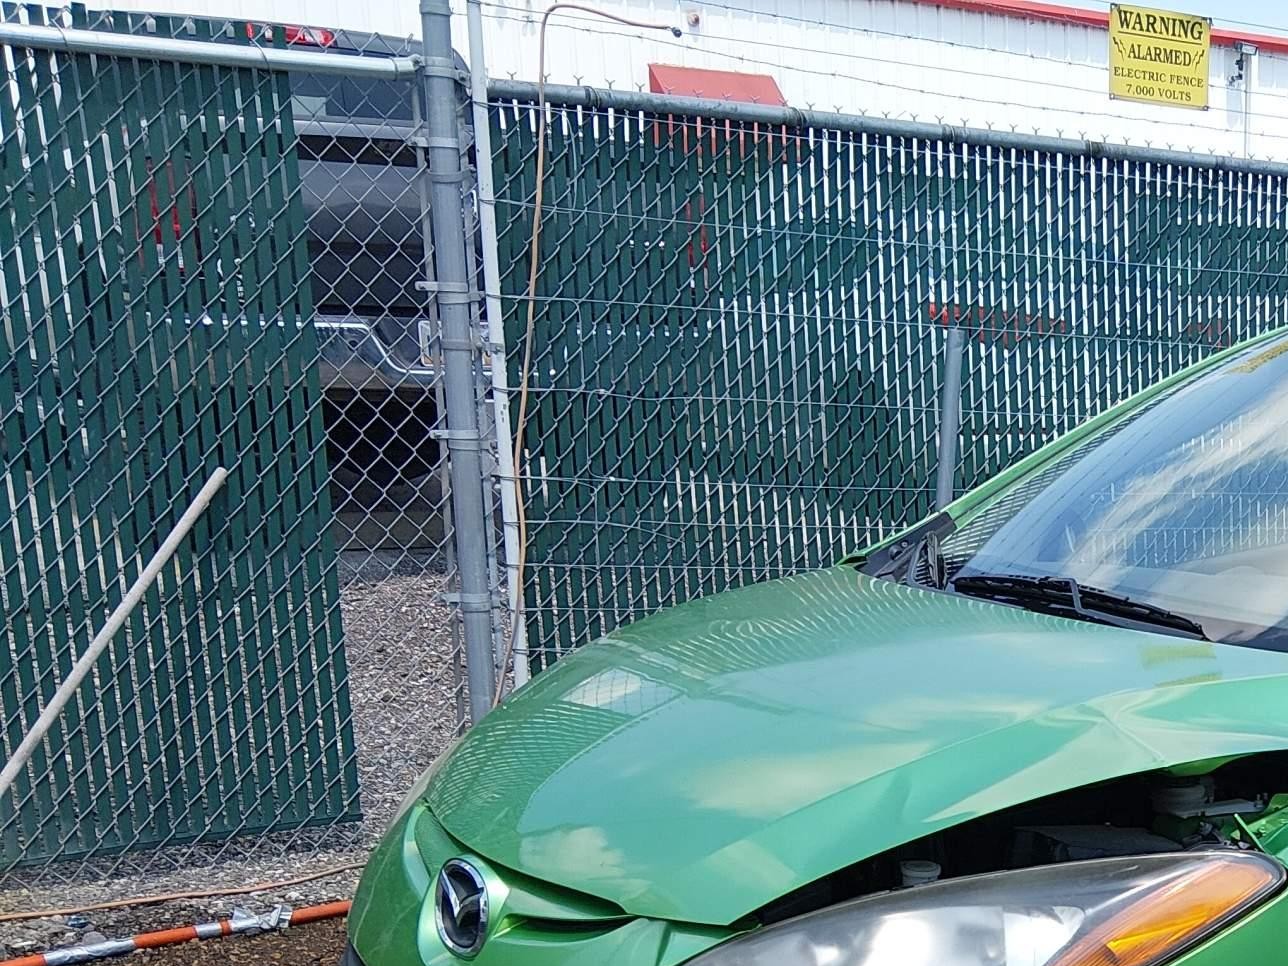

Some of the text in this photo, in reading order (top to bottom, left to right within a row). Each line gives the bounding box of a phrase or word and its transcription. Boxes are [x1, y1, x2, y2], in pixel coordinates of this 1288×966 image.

[1117, 9, 1204, 41] WARNING
[1128, 43, 1192, 67] ALARMED
[1114, 66, 1204, 88] ELECTRIC FENCE
[1126, 84, 1192, 102] 7,000 VOLTS
